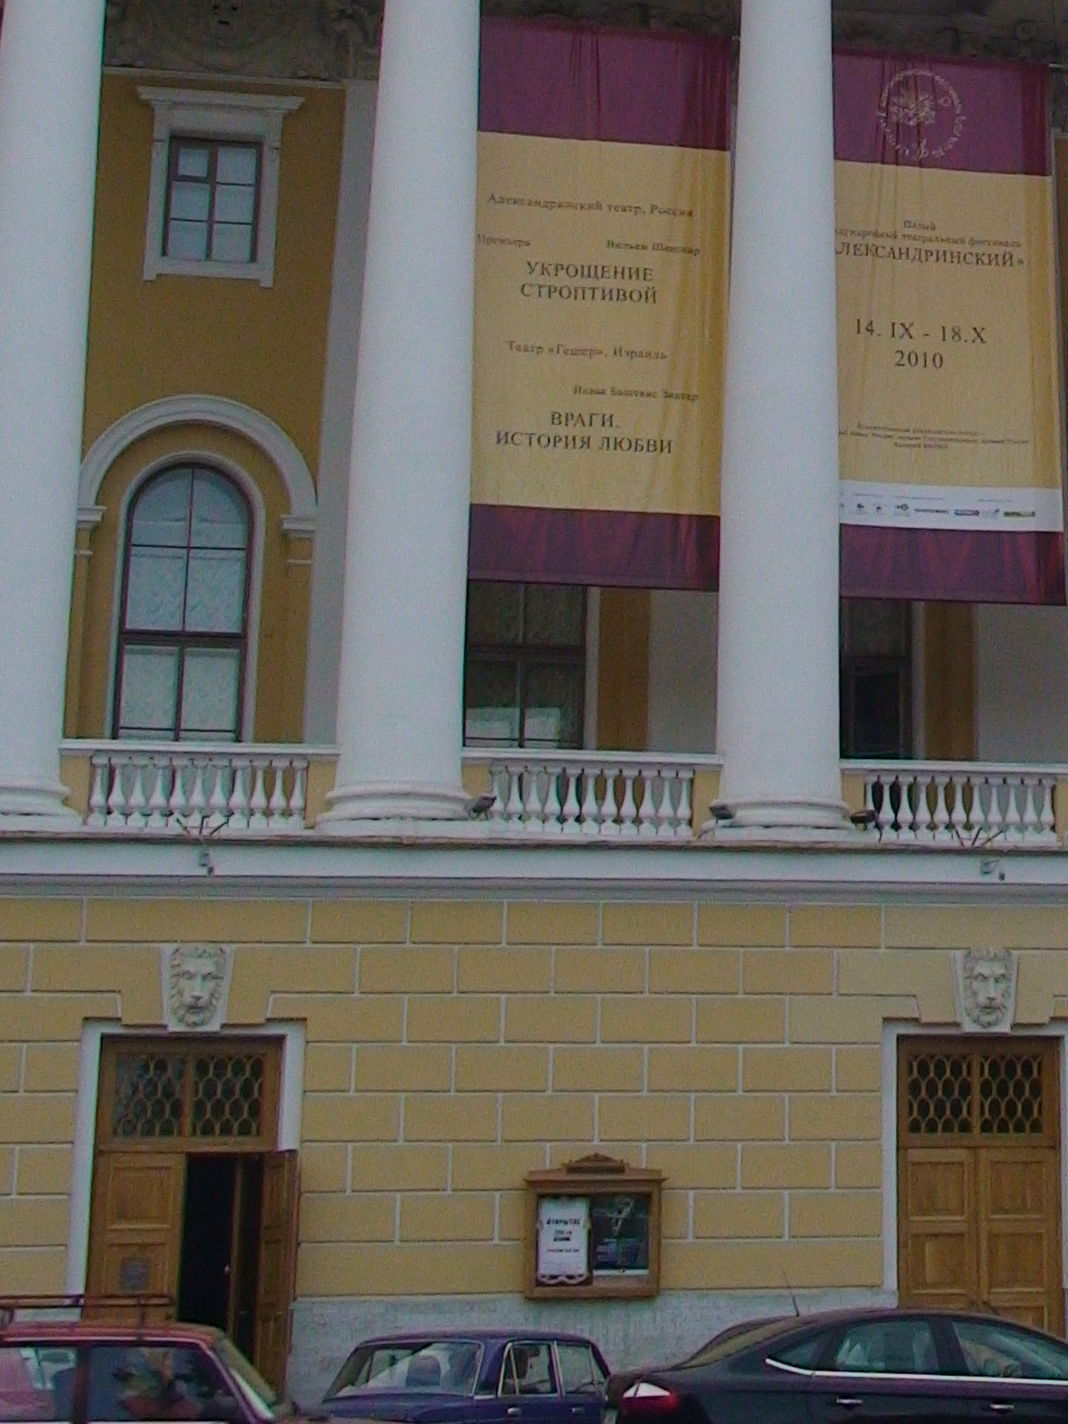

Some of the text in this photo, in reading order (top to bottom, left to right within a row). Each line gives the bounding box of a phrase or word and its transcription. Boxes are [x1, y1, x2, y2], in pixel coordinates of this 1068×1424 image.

[835, 241, 1024, 268] ЛЕКСАНДРИНСКИЙ»
[526, 260, 654, 282] УКРОЩЕНИЕ
[520, 282, 657, 304] СТРОПТИВОЙ
[856, 318, 882, 336] 14.
[894, 349, 944, 369] 2010
[495, 431, 673, 455] ИСТОРИЯ ЛЮБВИ
